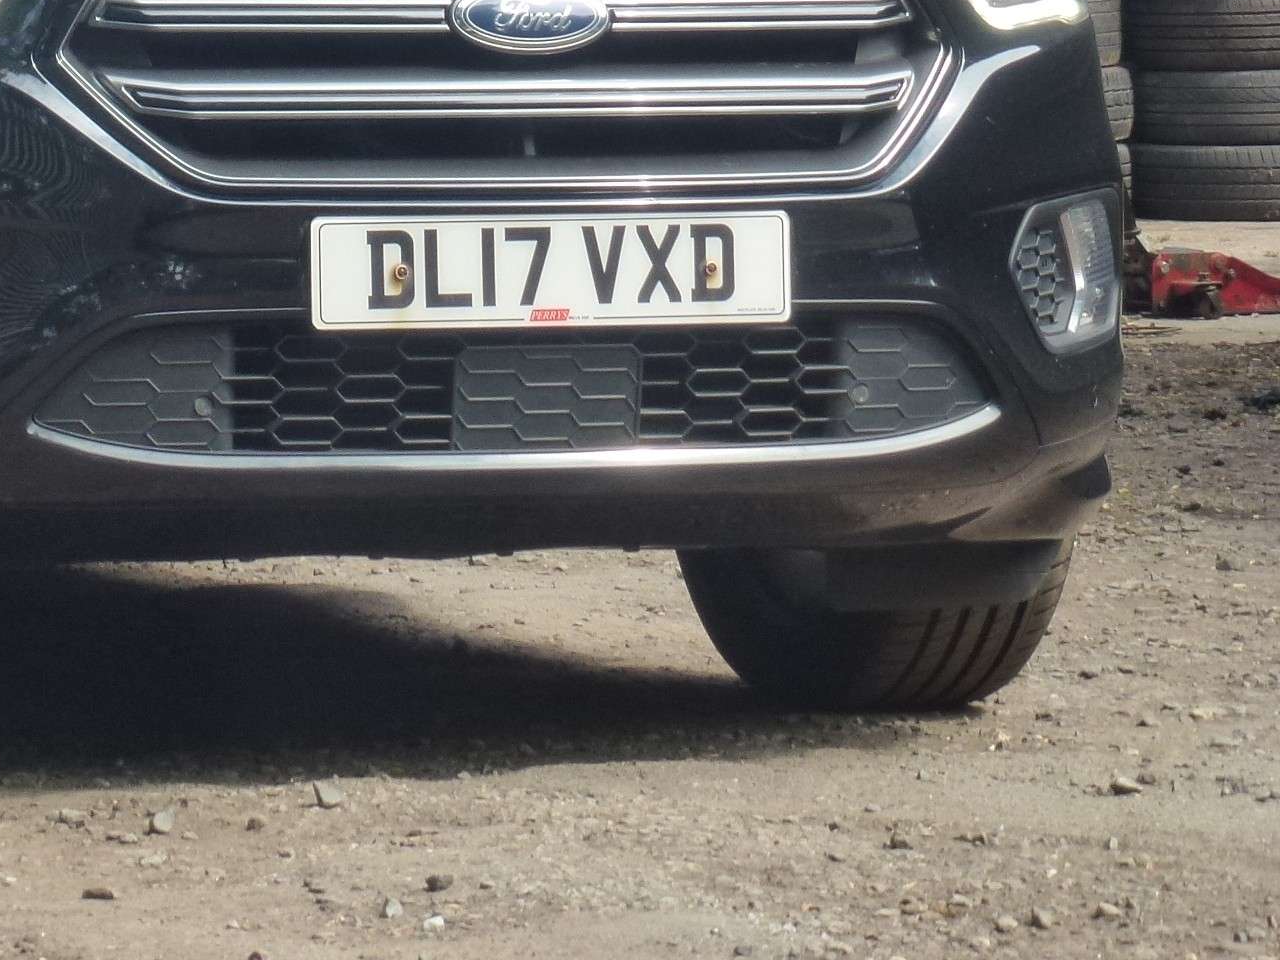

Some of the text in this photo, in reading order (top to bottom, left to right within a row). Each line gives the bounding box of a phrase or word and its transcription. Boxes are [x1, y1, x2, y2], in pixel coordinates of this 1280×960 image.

[366, 223, 735, 310] DL17 VXD
[530, 309, 570, 321] PERRYS
